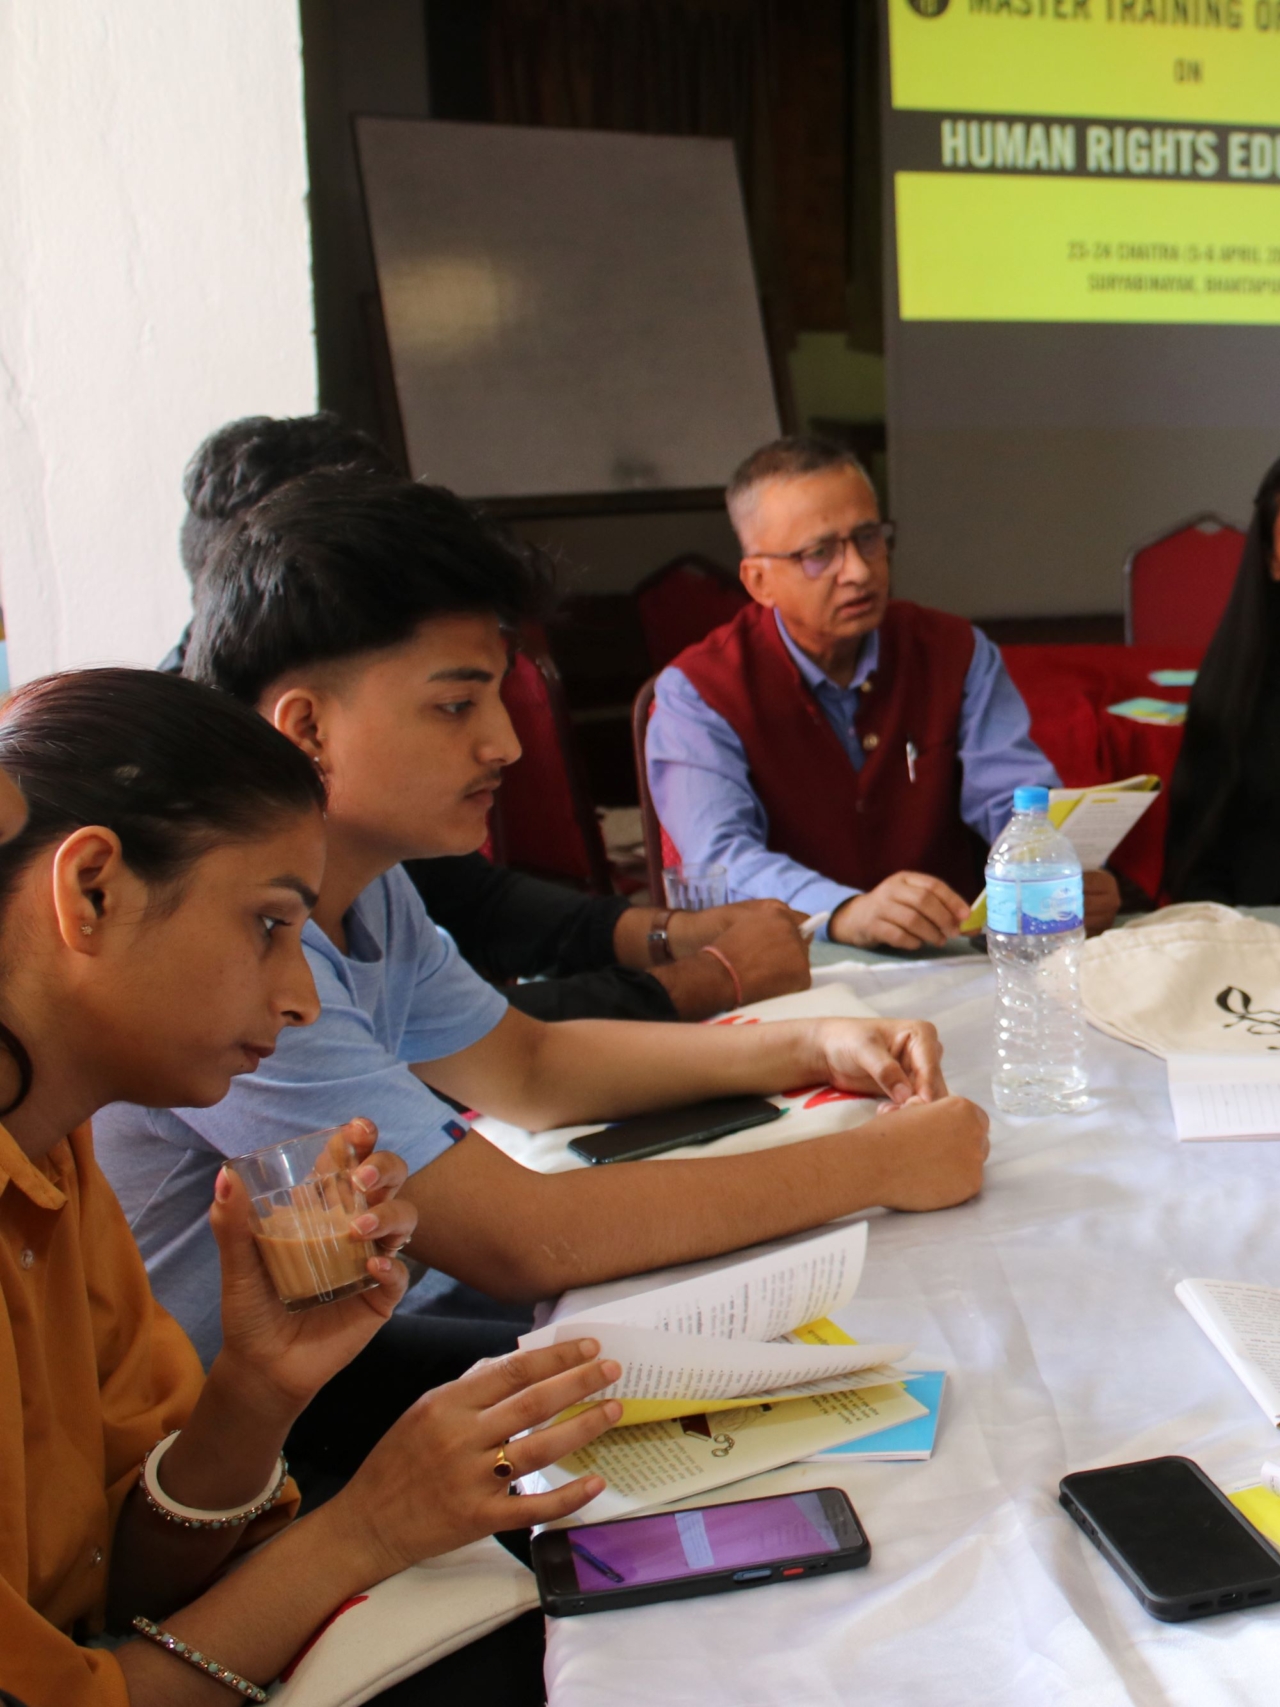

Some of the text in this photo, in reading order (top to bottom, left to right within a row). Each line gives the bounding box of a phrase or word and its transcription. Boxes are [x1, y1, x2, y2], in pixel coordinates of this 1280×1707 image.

[1103, 0, 1243, 31] TRAINING
[1173, 58, 1204, 84] ON
[941, 119, 1076, 170] HUMAN
[1086, 126, 1219, 177] RIGHTS
[1116, 242, 1180, 263] CHAITRA
[1219, 244, 1261, 265] APRIL
